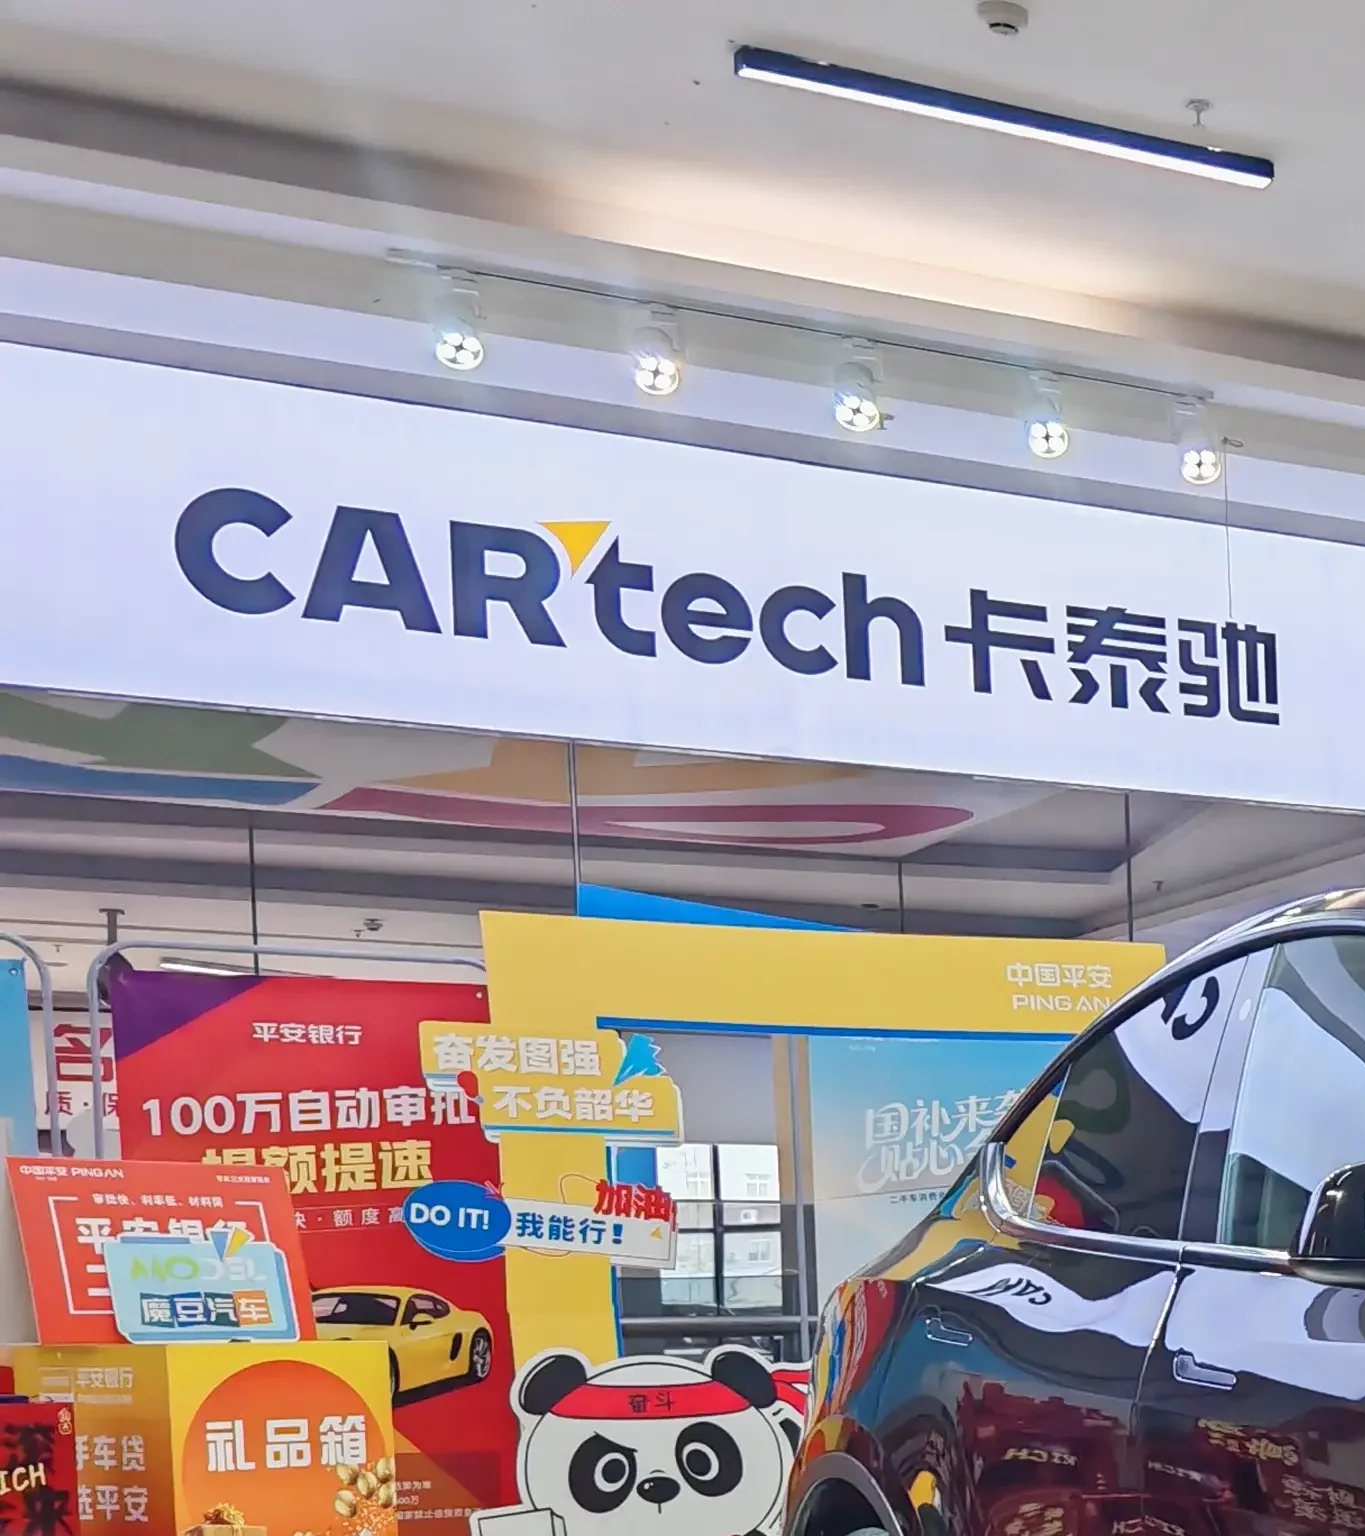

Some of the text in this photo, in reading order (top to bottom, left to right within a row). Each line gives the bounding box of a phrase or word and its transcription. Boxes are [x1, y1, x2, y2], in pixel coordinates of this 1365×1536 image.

[174, 487, 1281, 726] CARtech 卡泰驰
[1006, 962, 1112, 988] 中国平安
[1012, 993, 1072, 1011] PING
[252, 1022, 363, 1045] 平安银行
[433, 1033, 602, 1077] 奋发图强
[142, 1086, 476, 1136] 100万自动审批
[493, 1085, 654, 1123] 不负韶华
[409, 1202, 490, 1231] DO IT!
[141, 1296, 271, 1324] 魔豆汽车
[205, 1414, 367, 1472] 礼品箱
[0, 1462, 47, 1496] ICH
